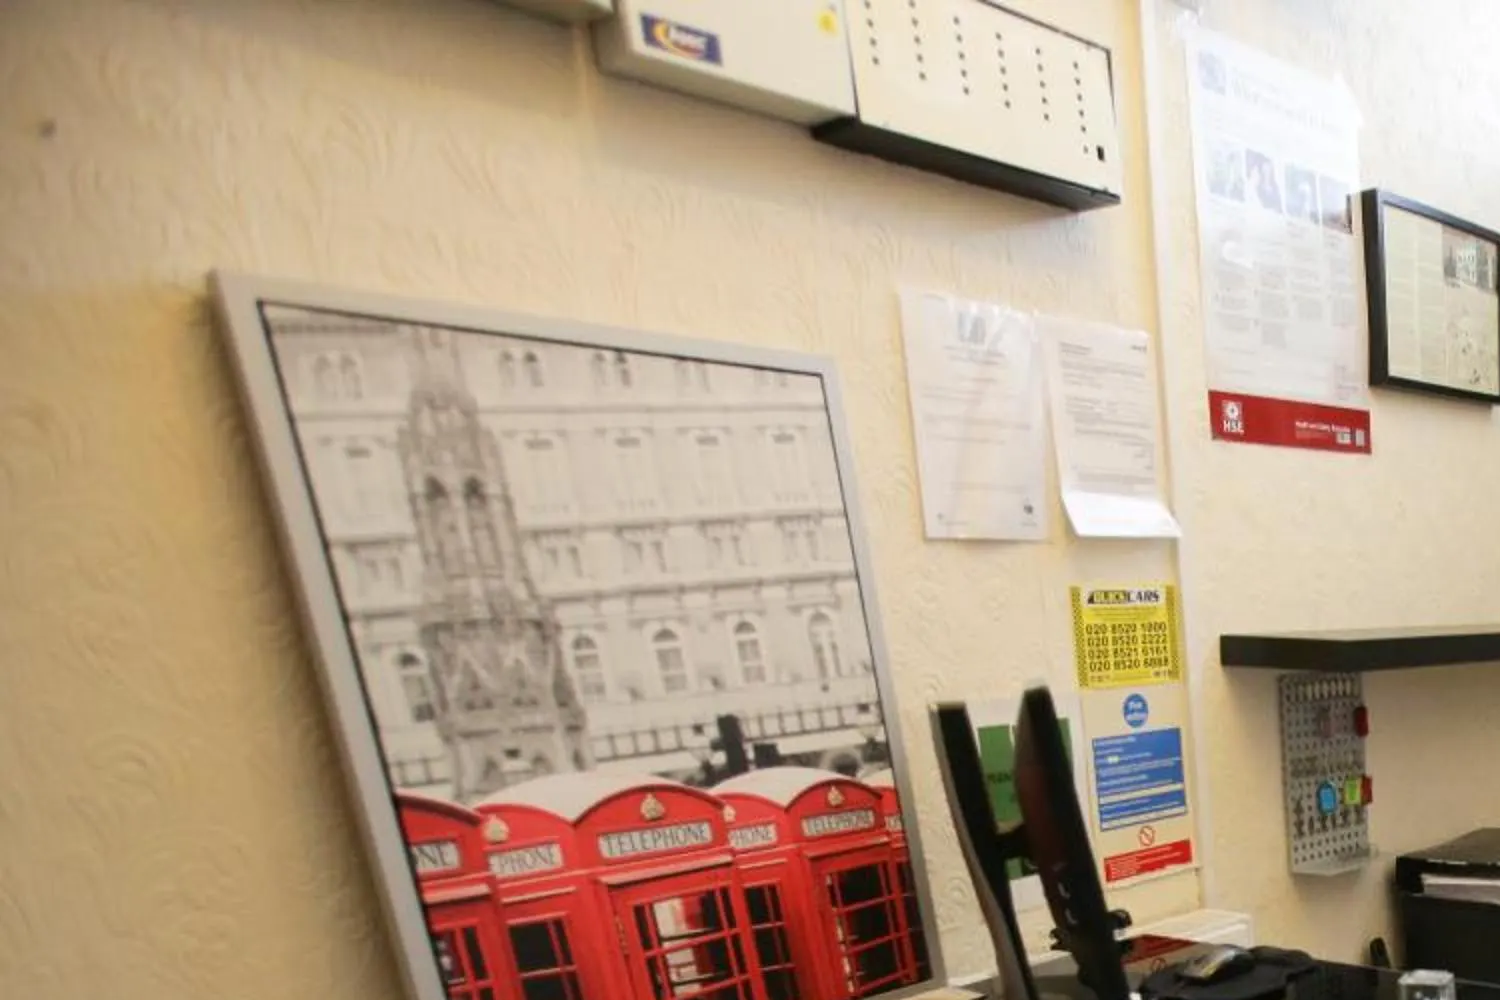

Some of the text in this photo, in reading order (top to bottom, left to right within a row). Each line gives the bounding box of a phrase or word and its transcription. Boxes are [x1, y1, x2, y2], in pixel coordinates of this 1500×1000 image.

[1223, 419, 1244, 432] HSE
[1087, 636, 1109, 648] 020
[1089, 660, 1111, 672] 020
[603, 824, 709, 857] TELEPHONE
[500, 845, 559, 875] PHONE
